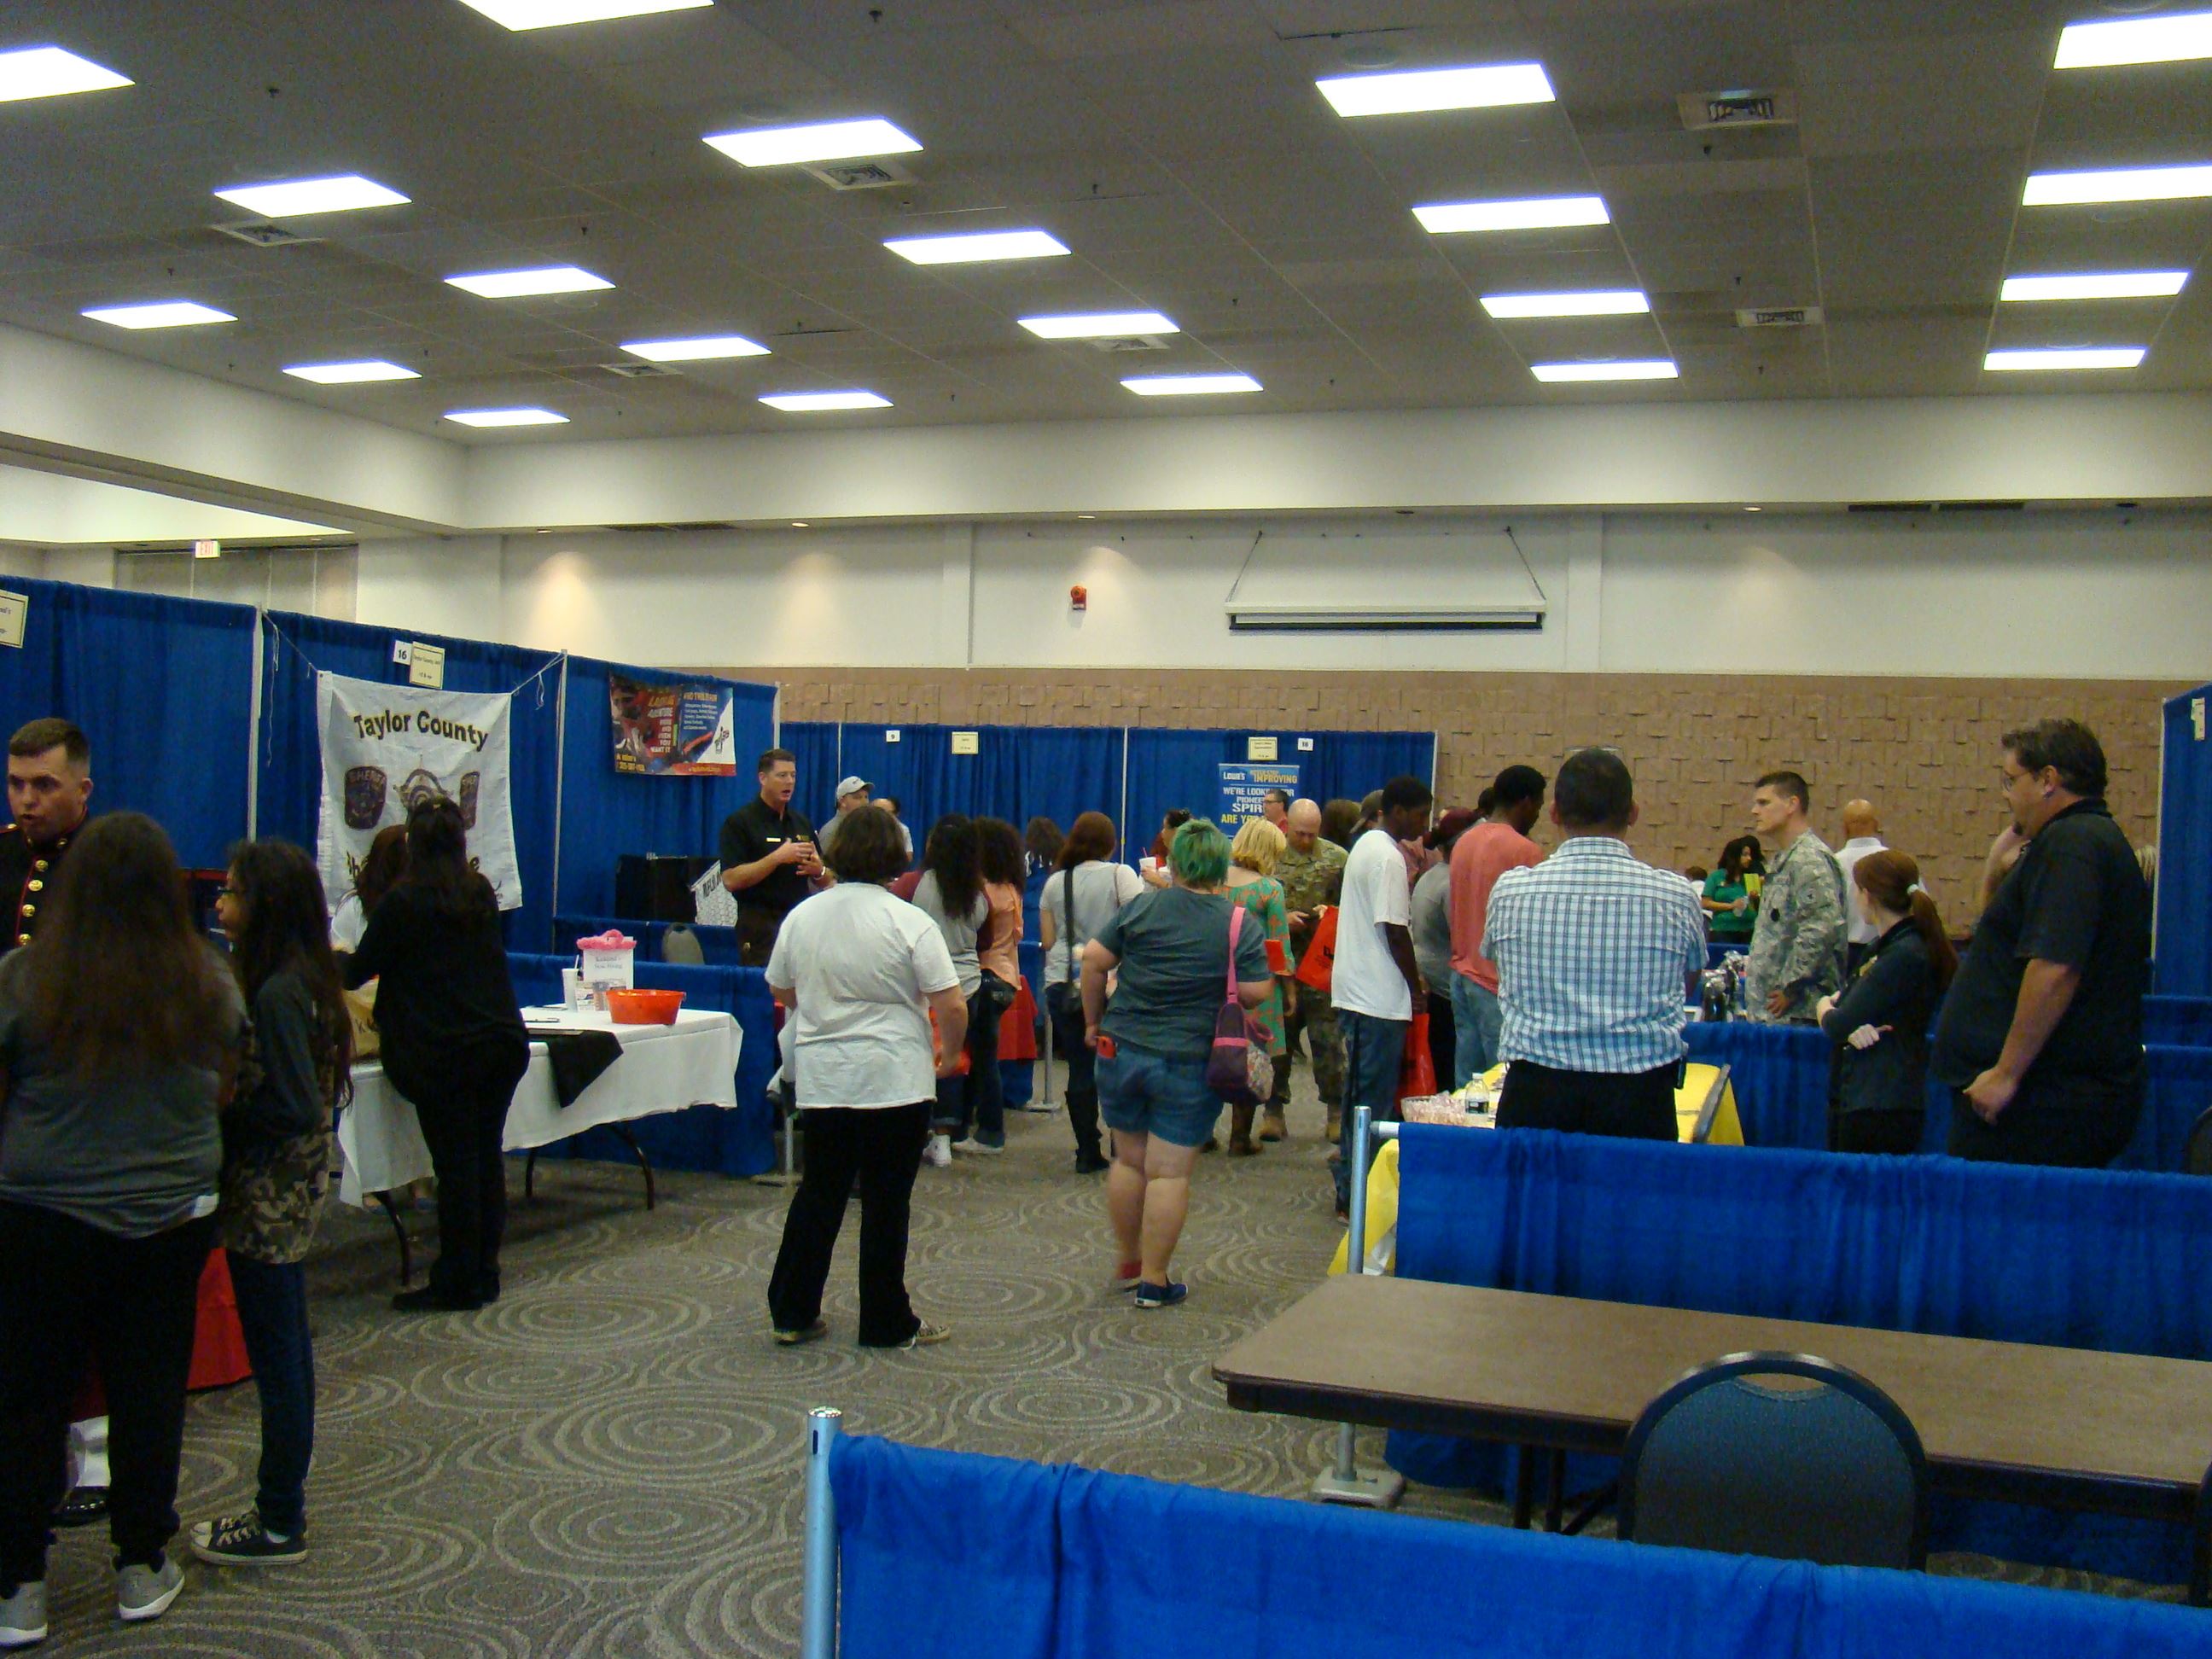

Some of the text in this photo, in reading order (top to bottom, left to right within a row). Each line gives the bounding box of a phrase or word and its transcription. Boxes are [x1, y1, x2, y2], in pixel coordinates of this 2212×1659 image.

[399, 649, 407, 661] 16
[353, 709, 489, 753] Taylor County
[1253, 773, 1298, 783] IMPROVING
[1223, 787, 1246, 795] WE'RE
[1220, 813, 1238, 824] ARE
